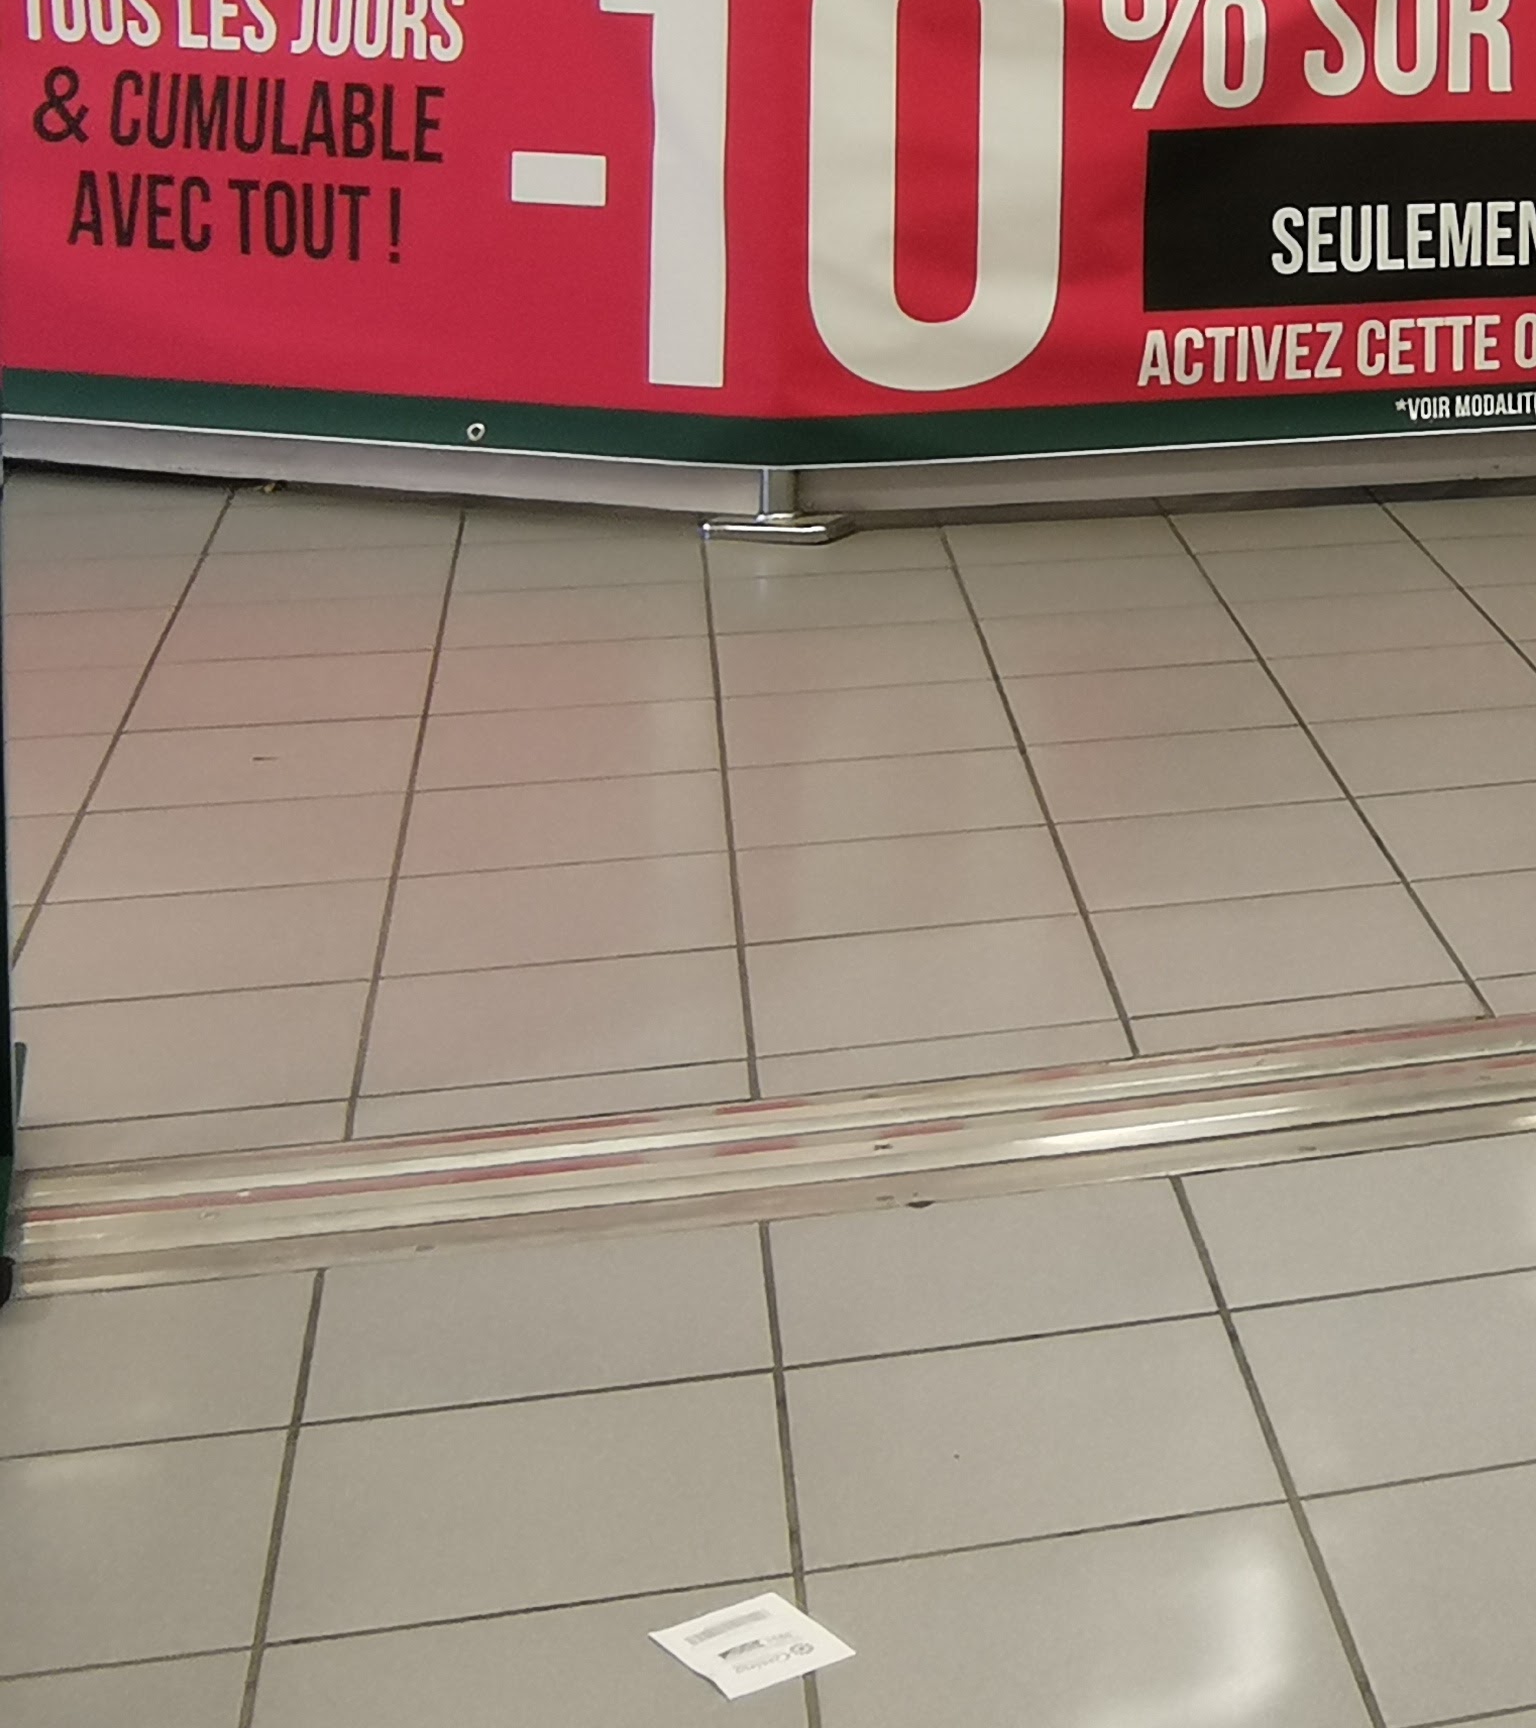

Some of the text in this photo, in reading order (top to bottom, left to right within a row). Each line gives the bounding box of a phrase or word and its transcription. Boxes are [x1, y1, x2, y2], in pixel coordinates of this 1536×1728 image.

[32, 67, 445, 163] & CUMULABLE
[66, 170, 402, 264] AVEC TOUT !
[1137, 320, 1344, 390] ACTIVEZ
[1355, 313, 1501, 379] CETTE
